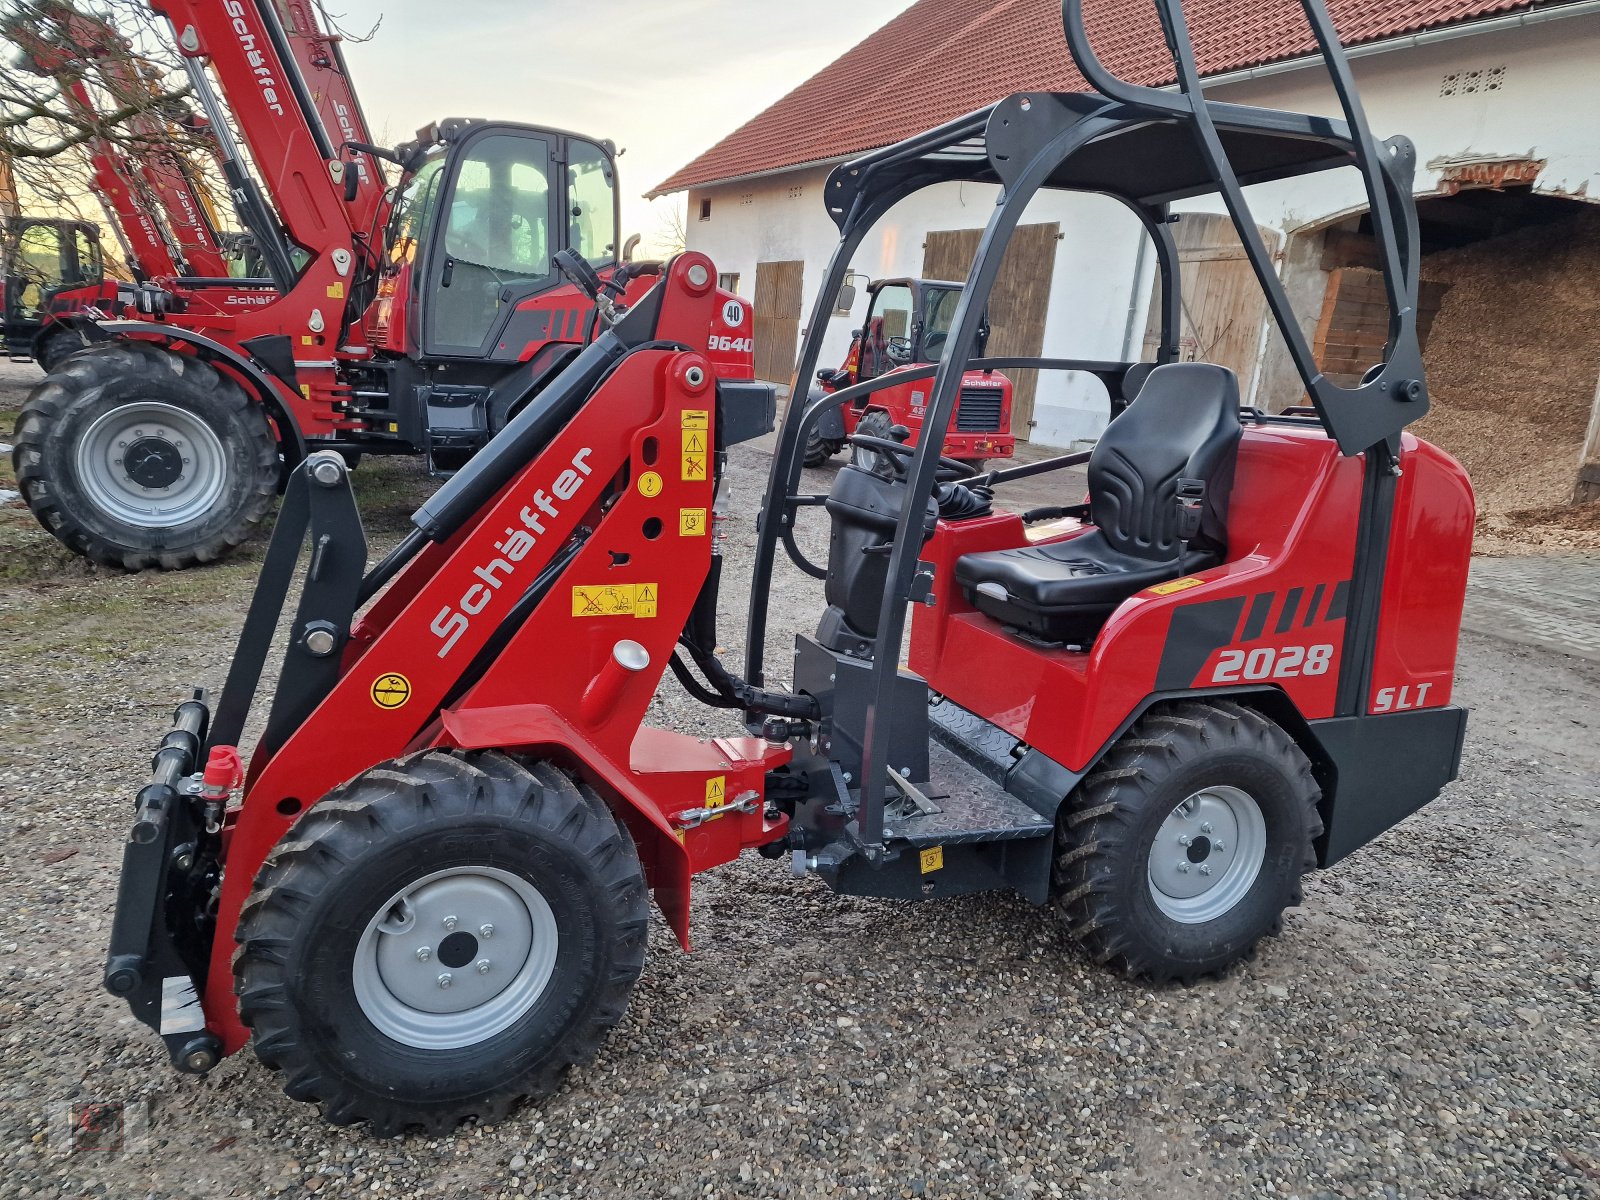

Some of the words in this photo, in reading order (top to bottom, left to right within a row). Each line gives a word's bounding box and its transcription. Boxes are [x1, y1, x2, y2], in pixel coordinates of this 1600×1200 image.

[223, 0, 284, 116] Schäffer
[333, 100, 370, 185] Schfer
[726, 305, 740, 322] 40
[708, 335, 753, 353] 9640
[911, 406, 927, 416] 42
[429, 446, 593, 659] Schäffer
[1211, 643, 1334, 683] 2028
[1373, 682, 1433, 713] SLT
